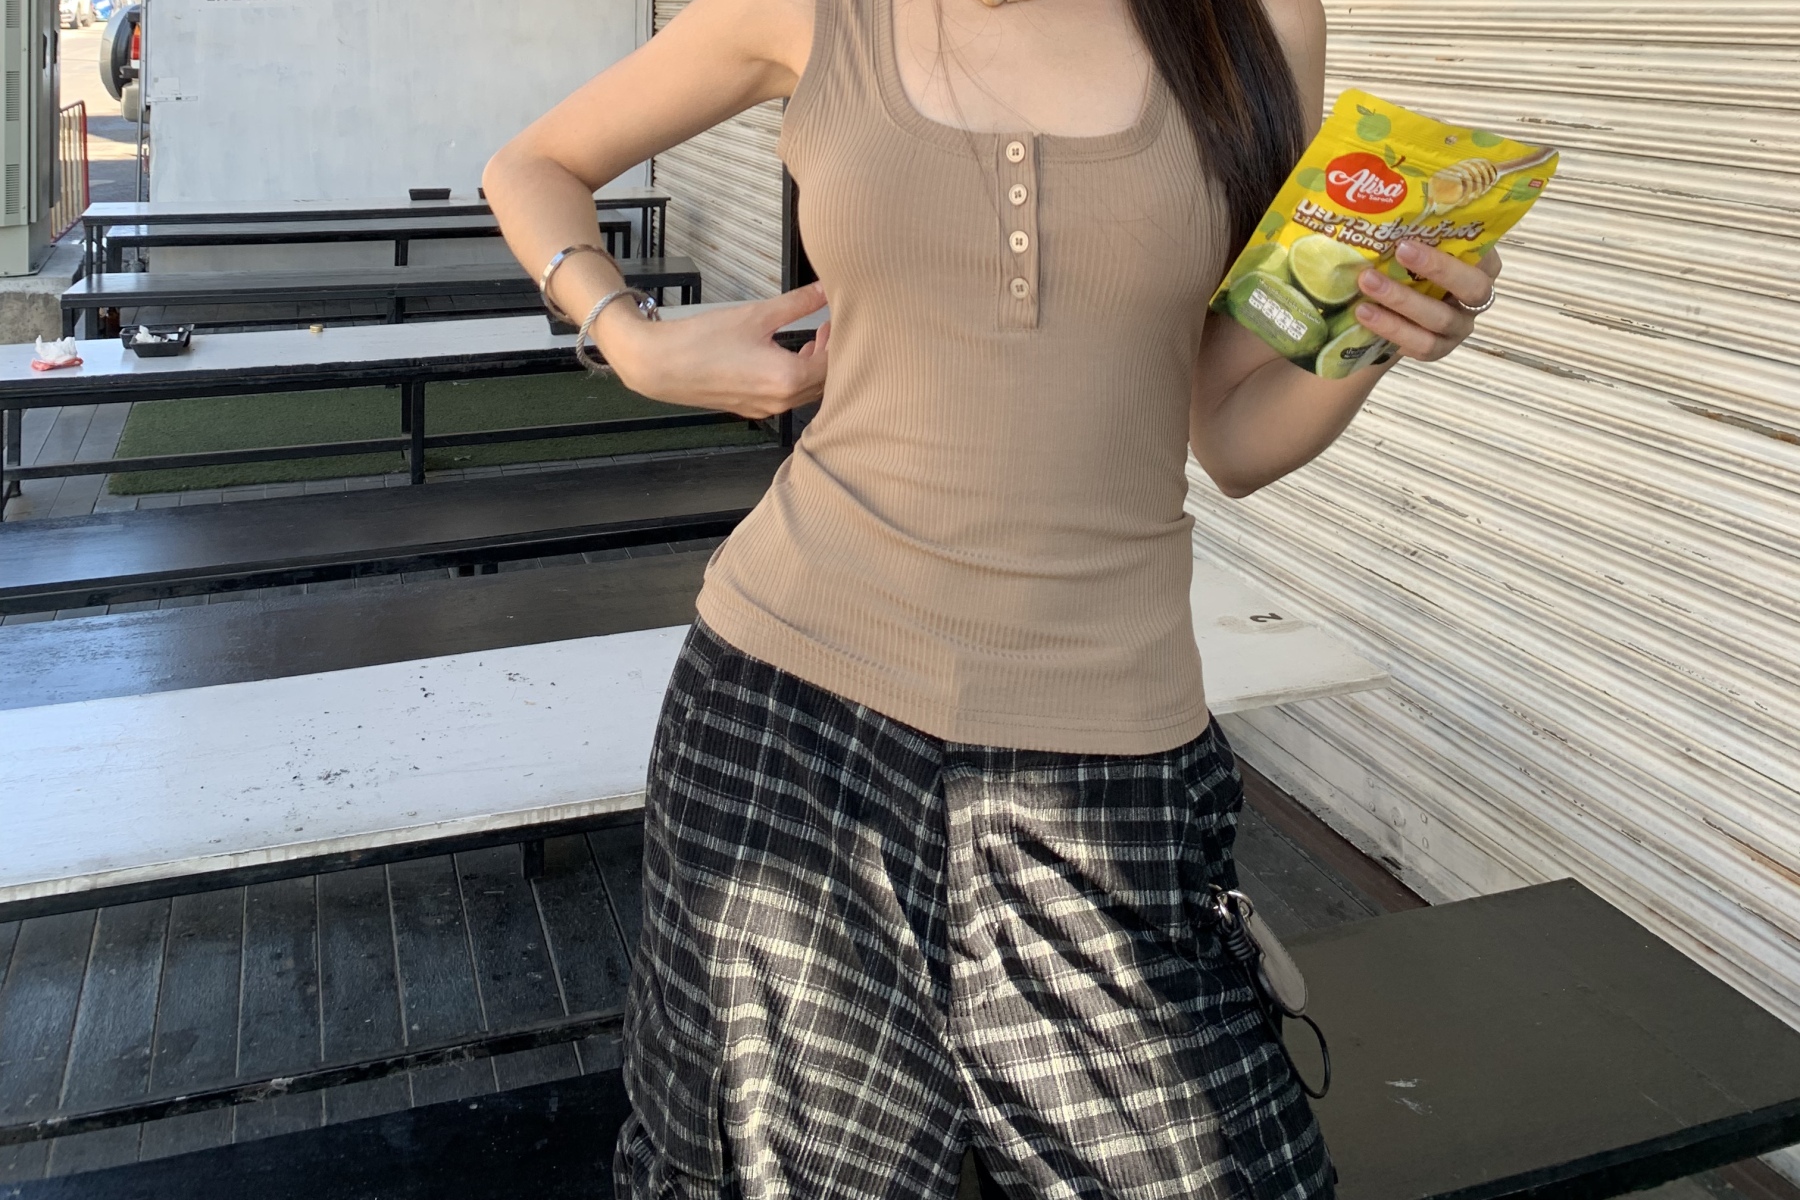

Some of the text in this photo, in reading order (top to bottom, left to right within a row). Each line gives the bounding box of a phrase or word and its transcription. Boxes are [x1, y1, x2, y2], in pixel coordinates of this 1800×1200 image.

[1328, 168, 1405, 203] Alisa
[1293, 212, 1336, 237] Lime
[1338, 226, 1395, 254] Honey
